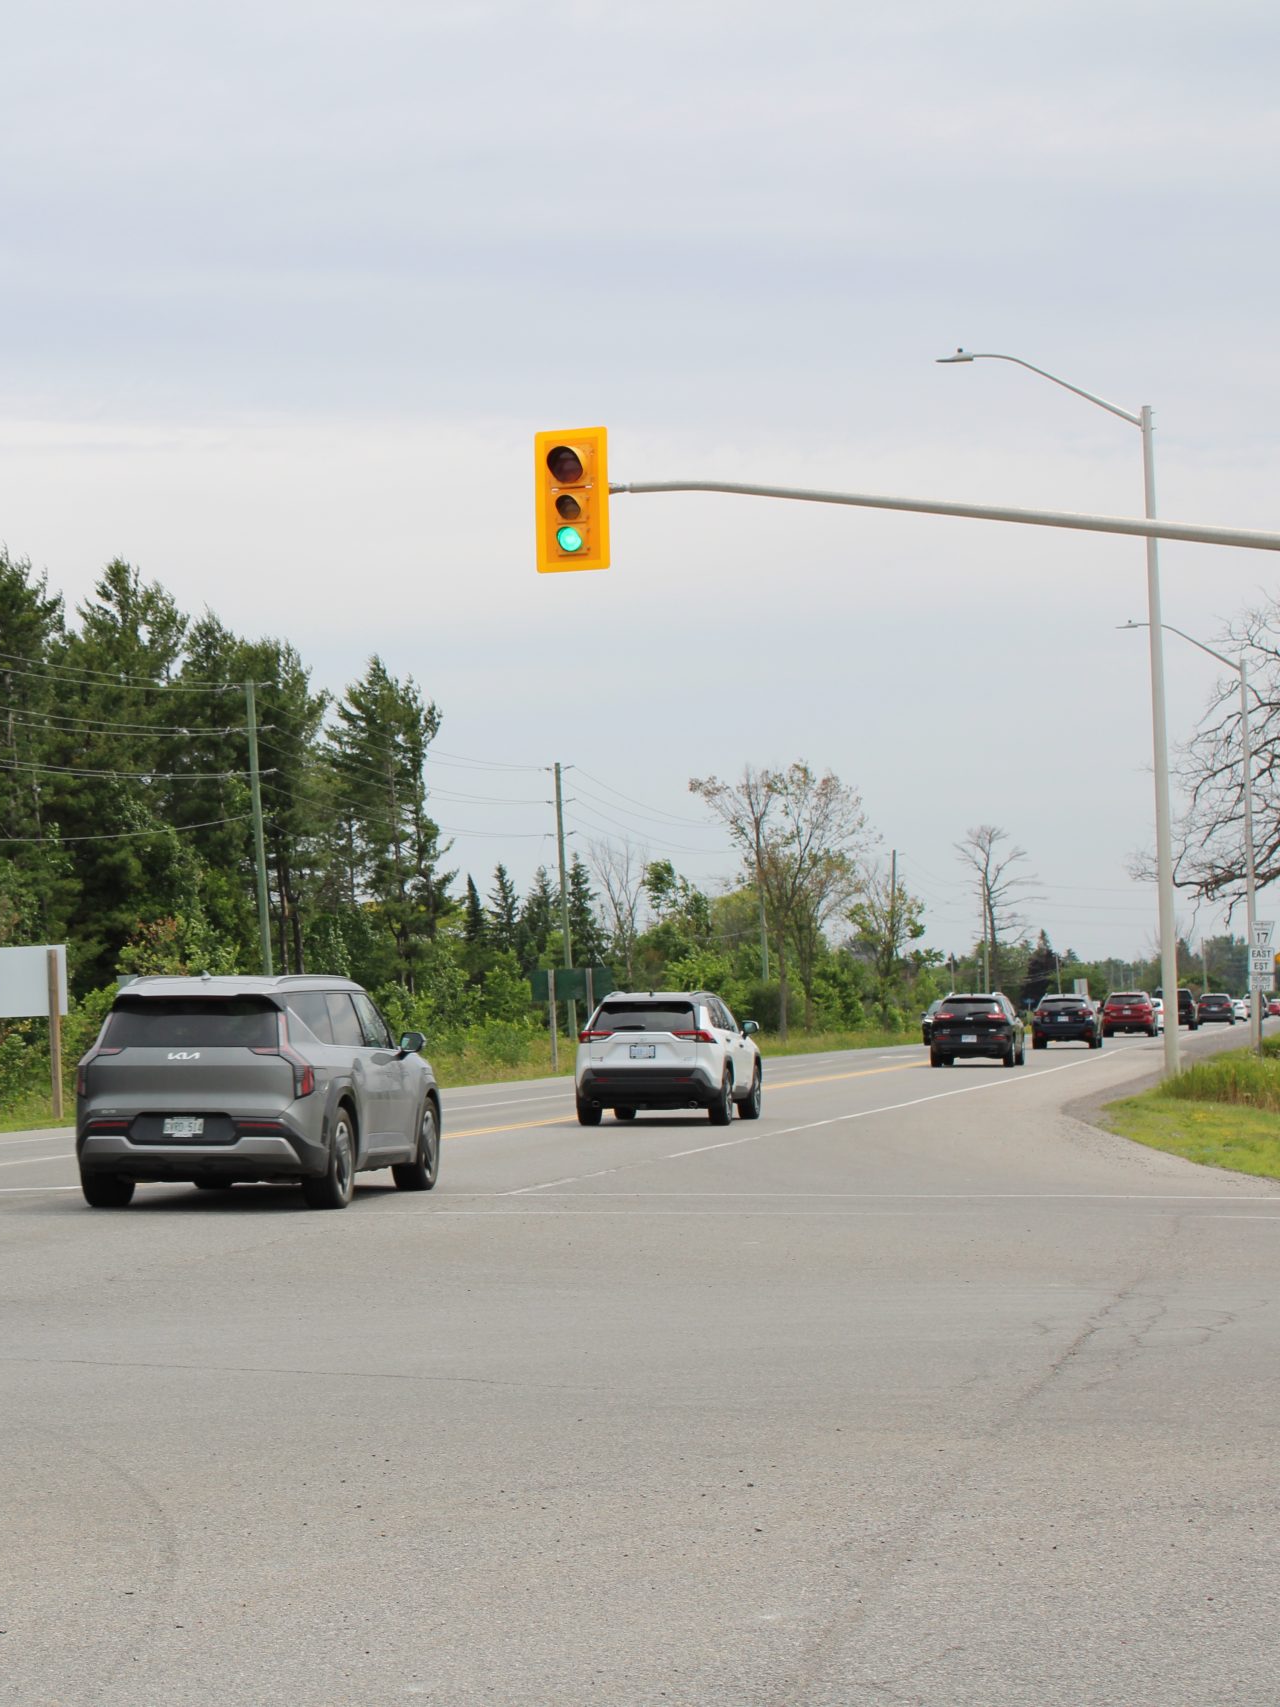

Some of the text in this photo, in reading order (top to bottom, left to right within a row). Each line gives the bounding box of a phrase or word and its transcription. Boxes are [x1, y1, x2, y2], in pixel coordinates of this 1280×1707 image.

[1256, 932, 1269, 944] 17
[1251, 949, 1271, 958] EAST
[1253, 962, 1269, 971] EST
[167, 1052, 201, 1060] KIA
